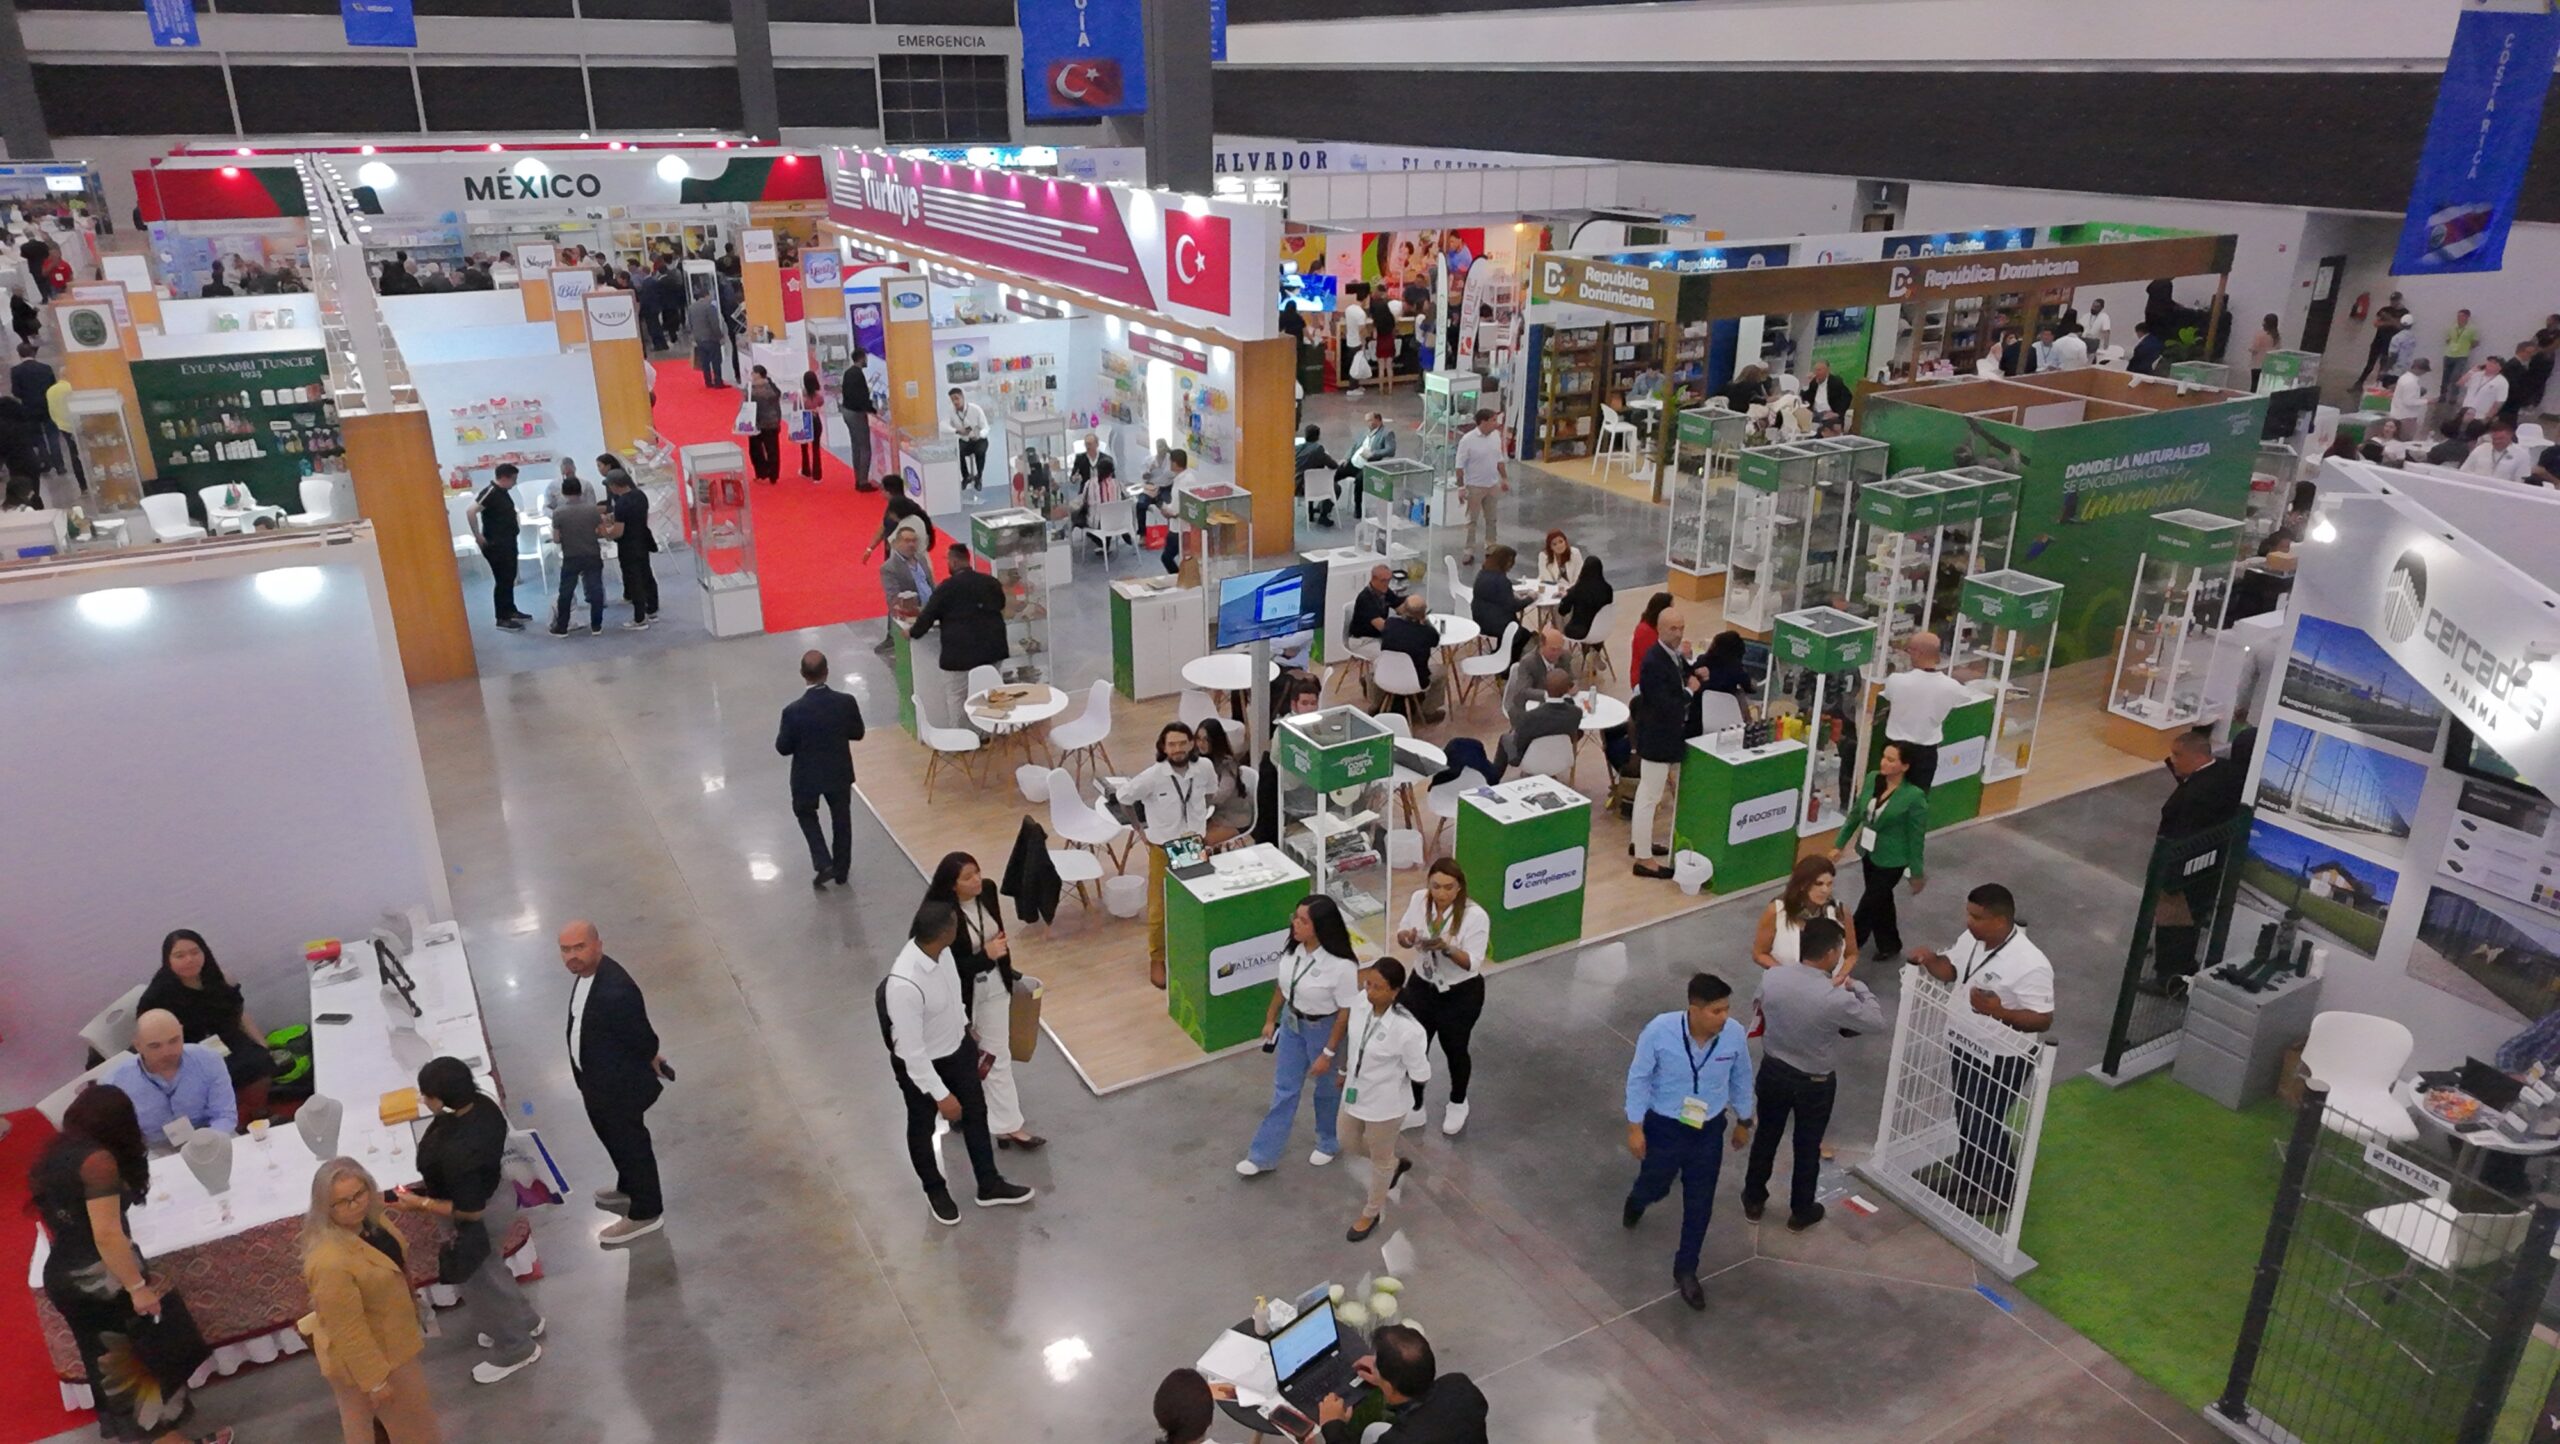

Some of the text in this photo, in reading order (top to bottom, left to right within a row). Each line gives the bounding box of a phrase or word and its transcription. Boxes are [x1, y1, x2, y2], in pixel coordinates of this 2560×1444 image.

[897, 34, 986, 48] EMERGENCIA
[2467, 33, 2516, 180] COSTA RICA
[1215, 150, 1328, 173] ALVADOR
[463, 167, 602, 201] MÉXICO
[860, 166, 920, 227] Türkiye
[1923, 258, 2080, 290] República Dominicana
[1579, 282, 1655, 310] Dominicana
[258, 355, 316, 370] TUNCER
[2065, 441, 2212, 480] DONDE LA NATURALEZA
[2063, 480, 2078, 494] SE
[2078, 468, 2145, 492] ENCUENTRA
[2146, 465, 2170, 479] CON
[2423, 607, 2548, 732] cercads
[1749, 806, 1787, 823] ROOSTER
[1526, 869, 1547, 880] Snap
[1956, 1033, 1990, 1058] RIVISA
[2386, 1156, 2440, 1191] RIVISA
